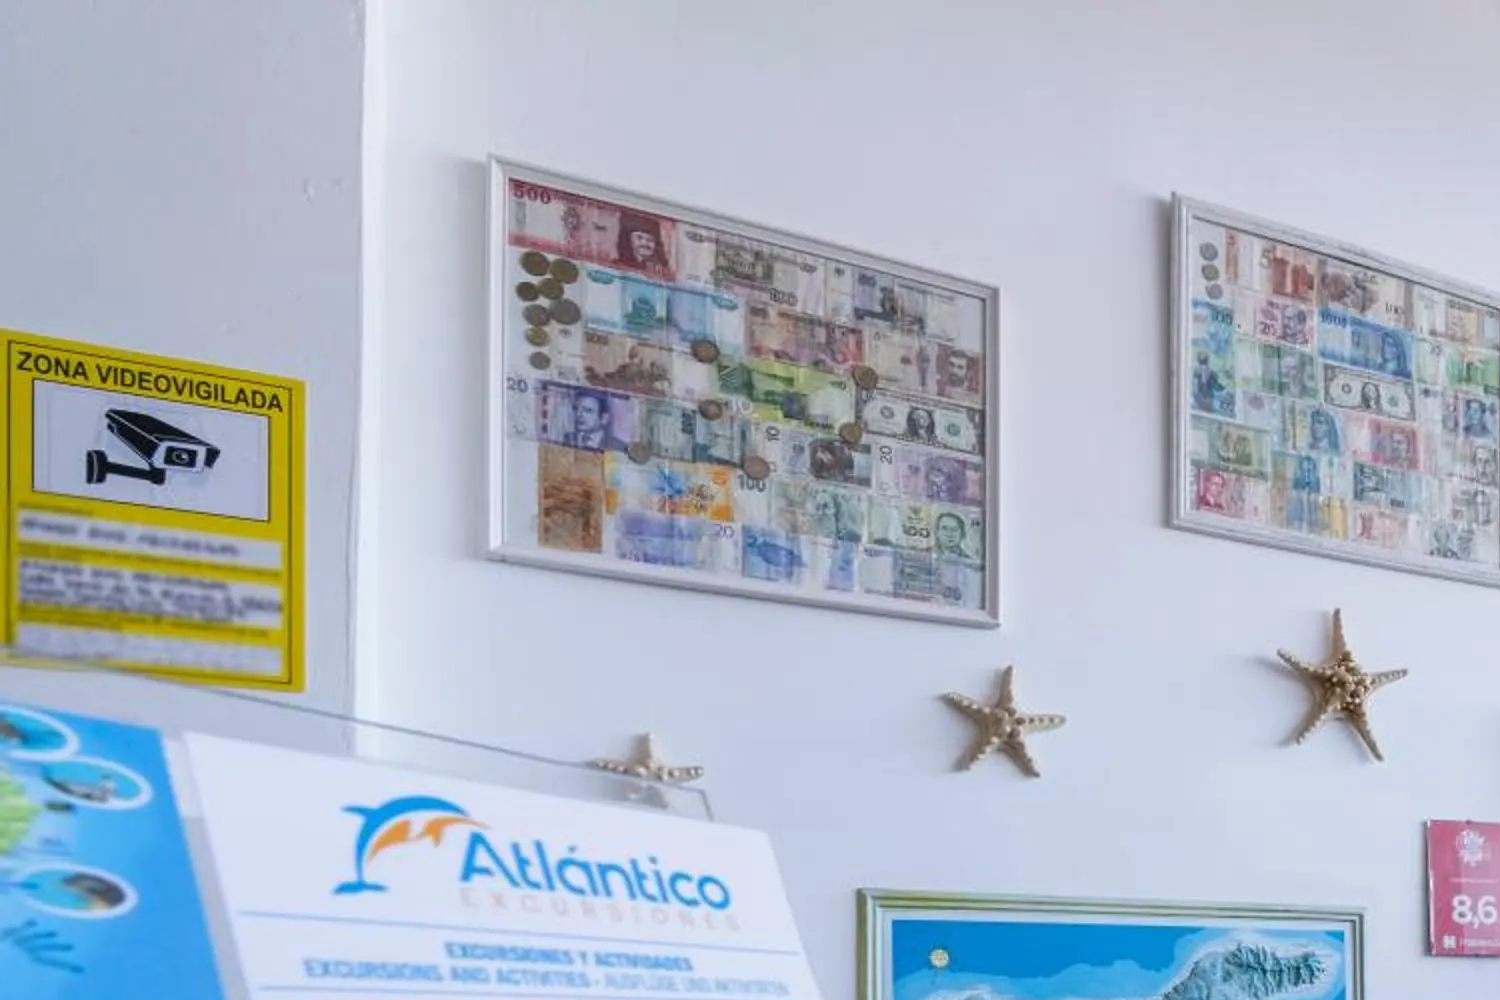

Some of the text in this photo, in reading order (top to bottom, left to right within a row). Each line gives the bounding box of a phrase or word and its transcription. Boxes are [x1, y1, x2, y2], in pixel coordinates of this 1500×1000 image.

[16, 350, 284, 413] ZONA VIDEOVIGILADA
[506, 376, 528, 393] 20
[460, 831, 731, 911] Atlántico
[459, 885, 740, 933] EXCURSIONES
[1451, 894, 1498, 930] 8,6
